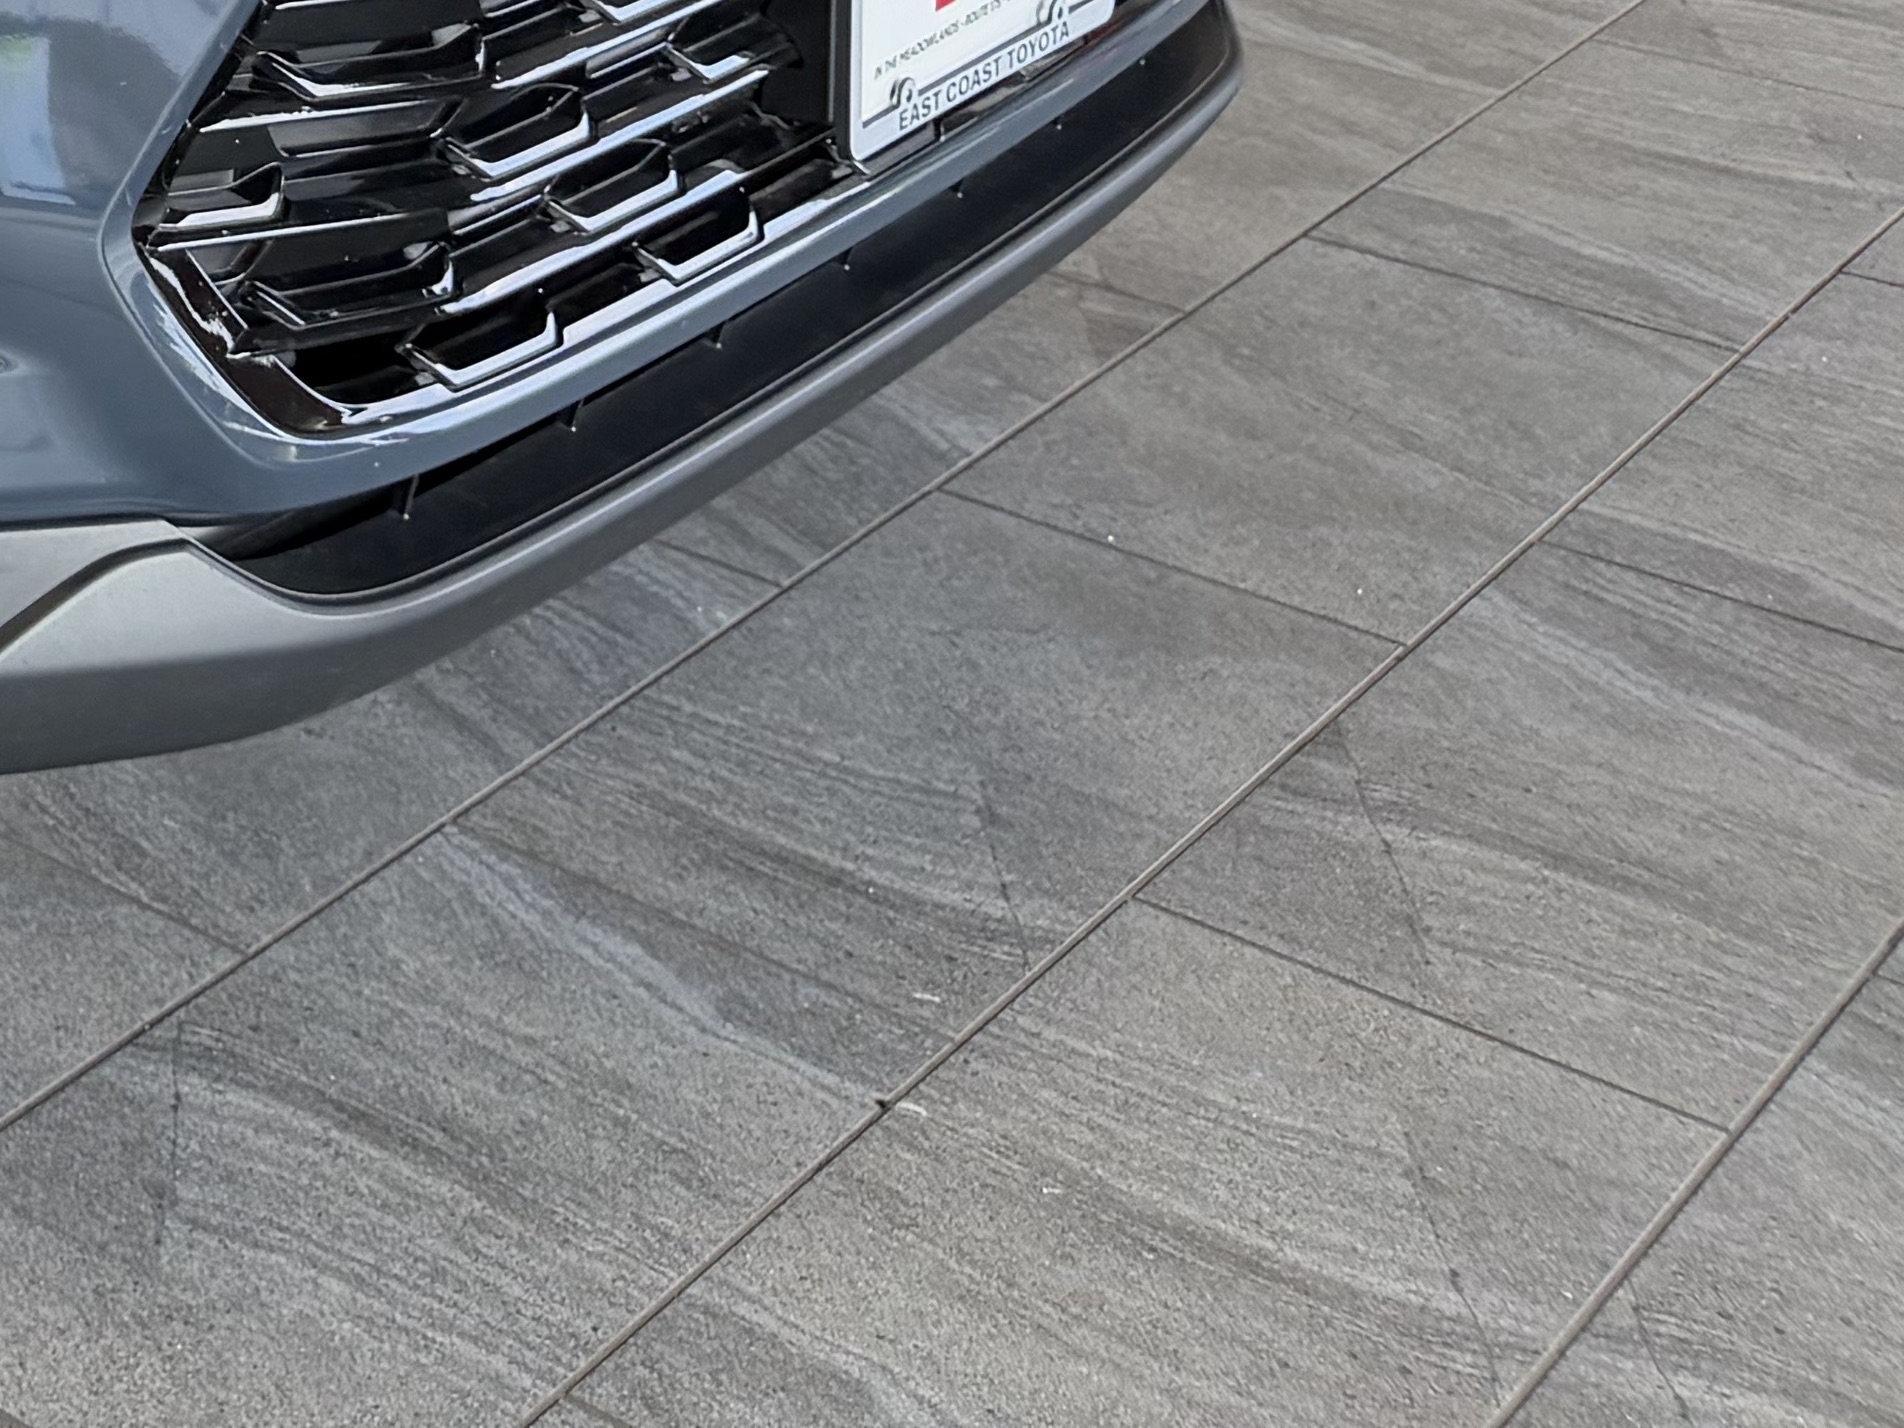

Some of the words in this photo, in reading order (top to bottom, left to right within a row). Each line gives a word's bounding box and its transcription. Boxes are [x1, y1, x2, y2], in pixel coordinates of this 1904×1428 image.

[899, 92, 942, 131] EAST
[945, 55, 1002, 104] COAST
[1004, 21, 1070, 70] TOYOTA
